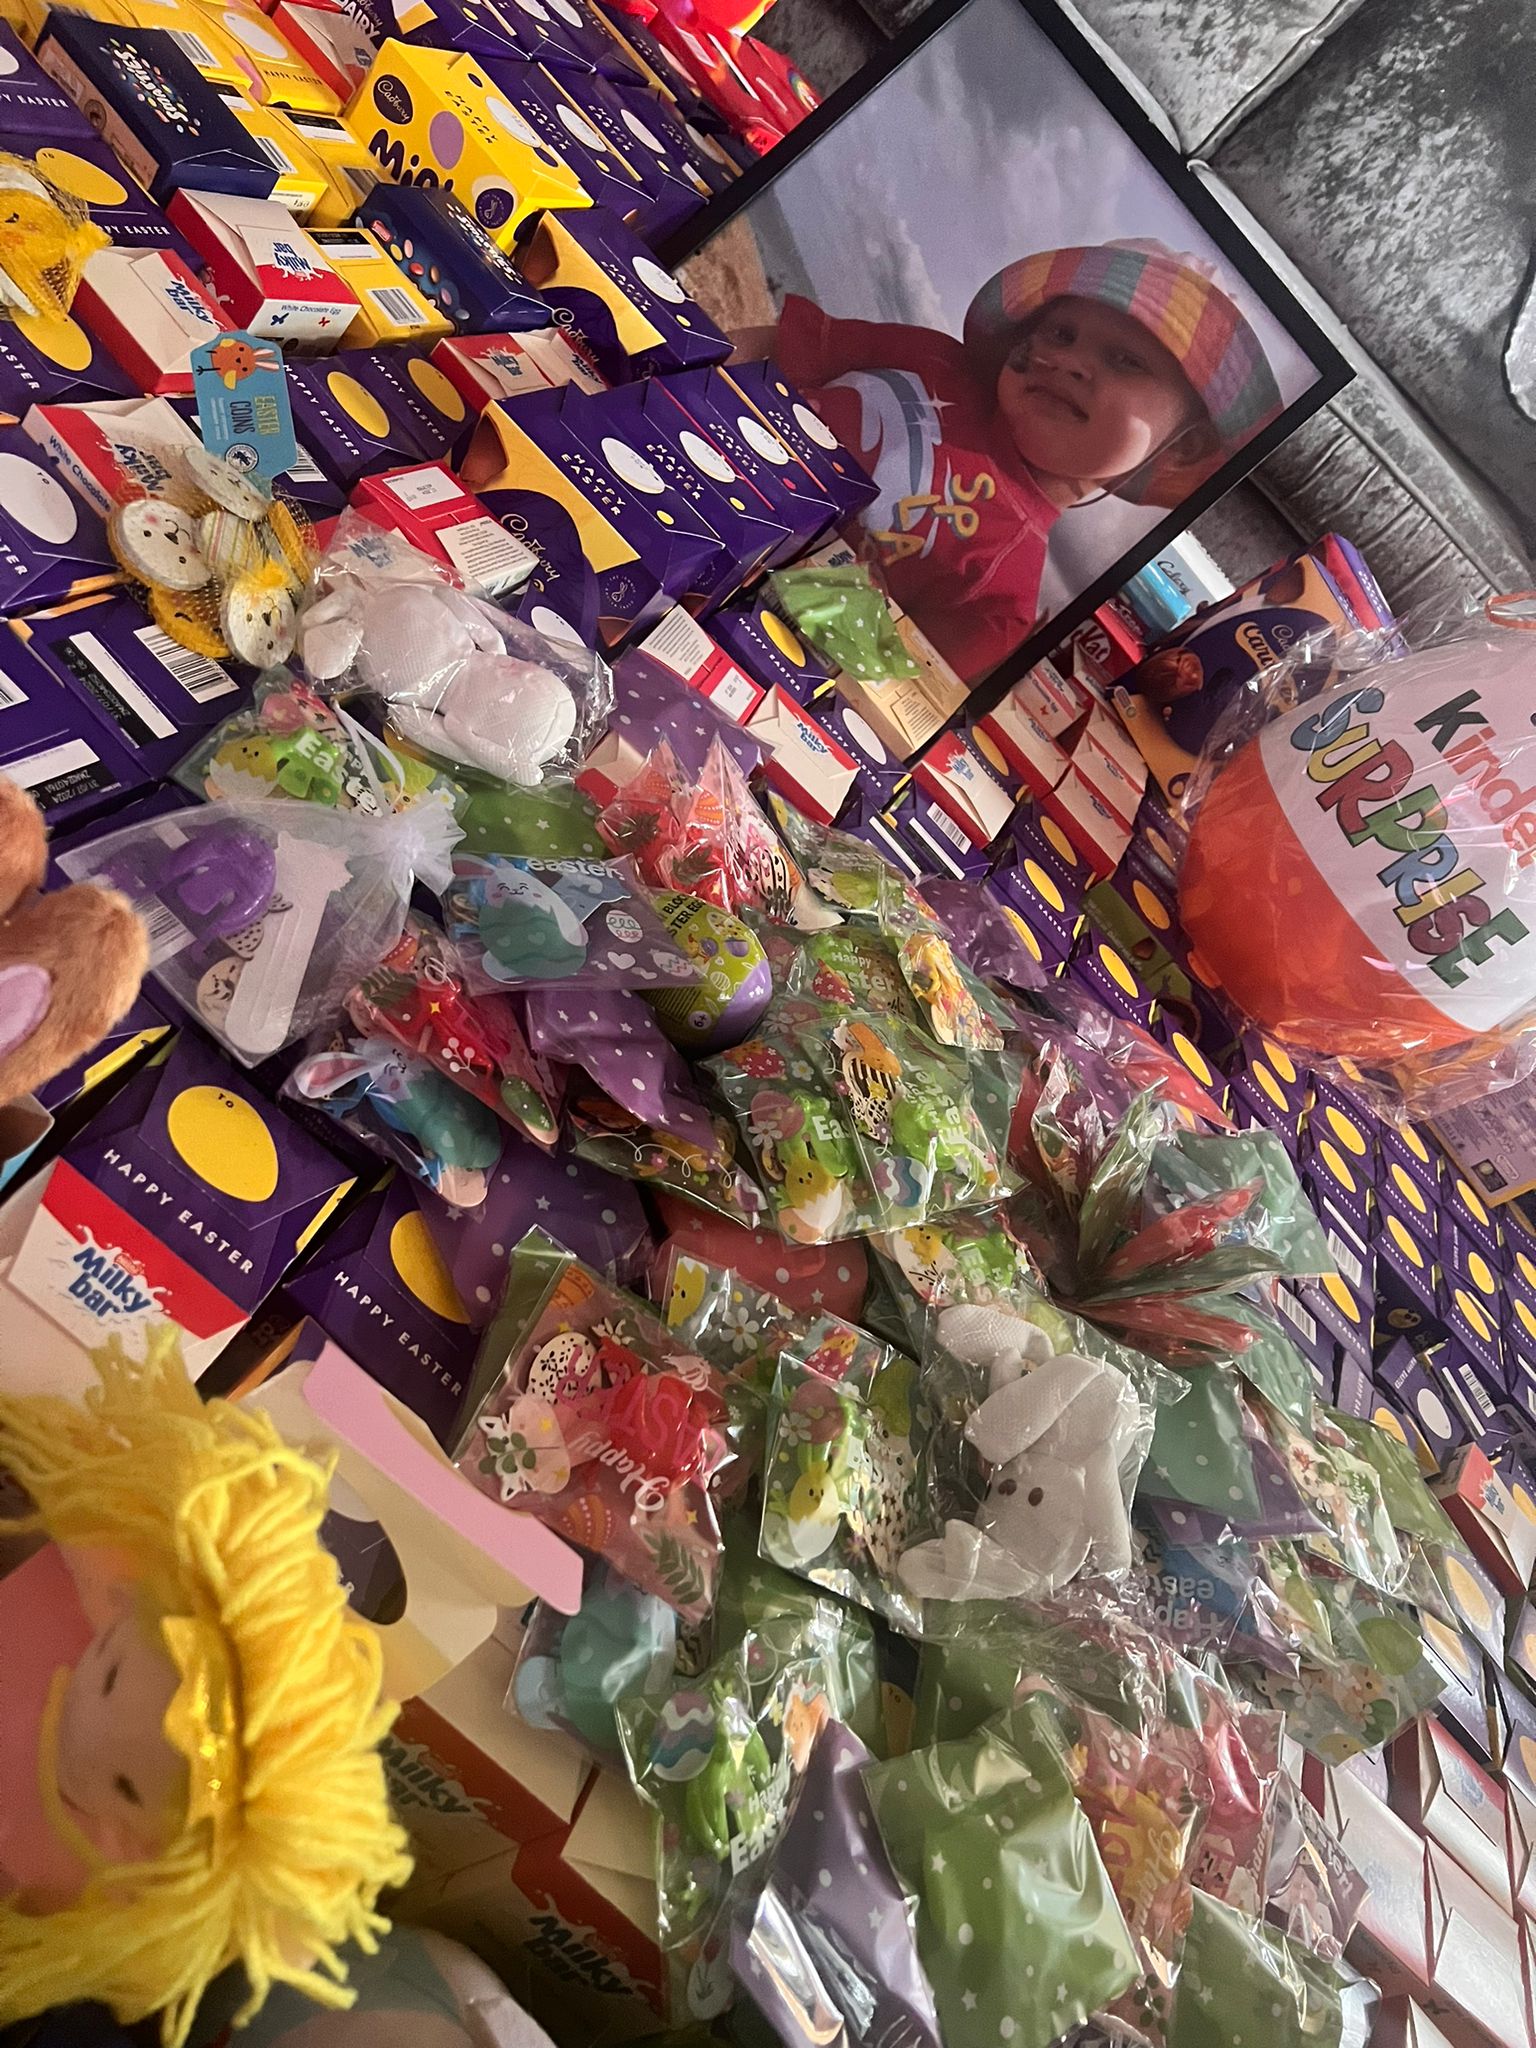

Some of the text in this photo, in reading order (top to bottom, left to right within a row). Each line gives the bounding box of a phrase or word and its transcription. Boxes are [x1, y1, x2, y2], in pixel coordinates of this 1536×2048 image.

[17, 95, 69, 108] EASTER
[377, 79, 410, 122] Cadbury
[368, 129, 454, 192] Min
[125, 225, 170, 235] EASTER
[166, 288, 194, 316] bar
[171, 280, 212, 325] Milky
[281, 304, 299, 312] White
[300, 306, 329, 314] Chocolate
[552, 308, 599, 364] Cadbury
[0, 338, 40, 390] ASTER
[230, 401, 255, 434] COINS
[370, 356, 405, 394] HAPPY
[407, 399, 446, 442] EASTER
[320, 410, 360, 456] EASTER
[50, 436, 112, 512] White Chocolate
[561, 453, 621, 516] EASTER
[574, 454, 626, 506] HAPPY
[646, 444, 701, 500] EASTER
[656, 444, 704, 491] HAPPY
[739, 617, 767, 649] HAPPY
[769, 654, 801, 692] EASTER
[1079, 627, 1109, 662] Kat
[797, 721, 828, 754] Milky
[820, 716, 882, 788] HAPPY EASTER
[1291, 687, 1530, 989] SURPRISE
[1010, 871, 1066, 937] HAPPY EASTER
[832, 952, 872, 968] Happy
[1087, 959, 1142, 1024] HAPPY EASTER
[693, 1015, 708, 1029] 6+
[219, 1093, 234, 1109] TO
[1242, 1076, 1291, 1136] HAPPY EASTER
[103, 1149, 254, 1274] HAPPY EASTER
[1311, 1159, 1361, 1218] HAPPY EASTER
[1381, 1236, 1403, 1263] HAPPY
[69, 1272, 119, 1317] bar
[73, 1247, 152, 1314] Milky
[334, 1271, 463, 1396] HAPPY EASTER
[565, 1434, 669, 1511] Happy
[529, 1916, 633, 1995] Milky
